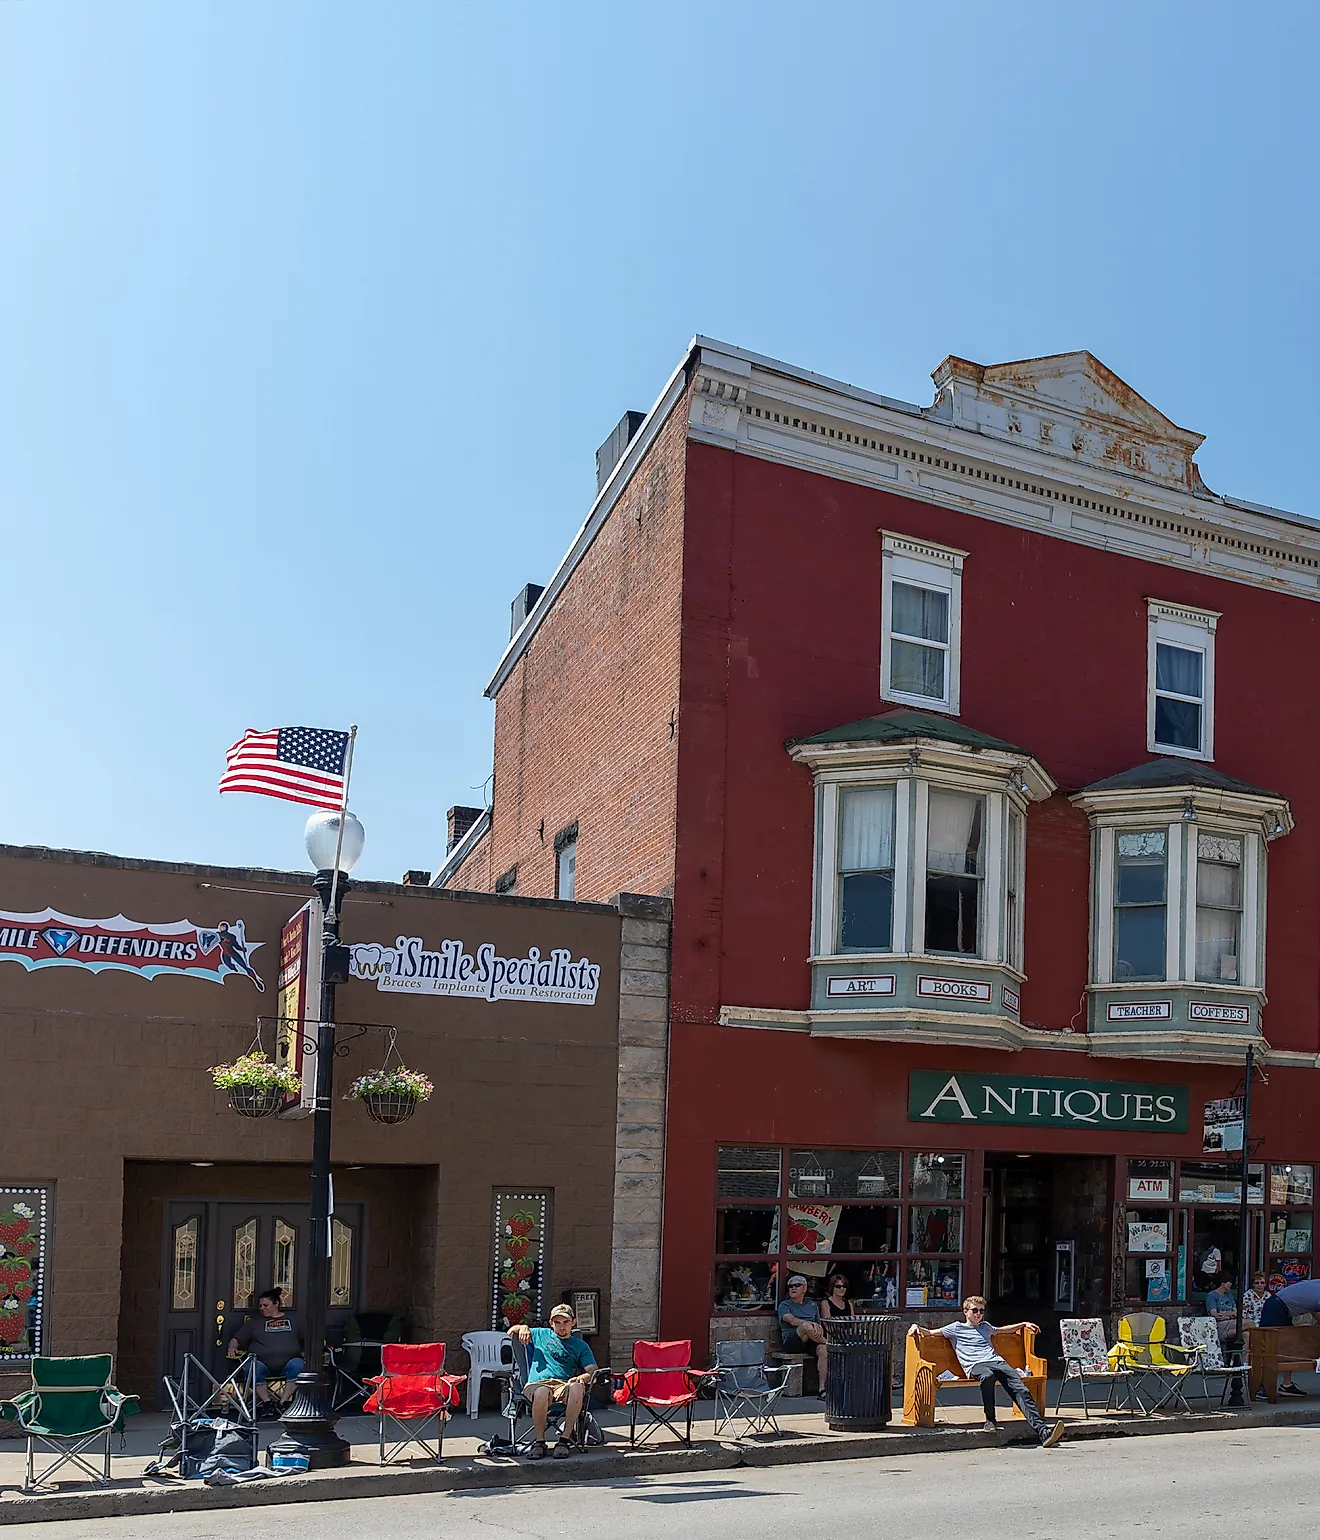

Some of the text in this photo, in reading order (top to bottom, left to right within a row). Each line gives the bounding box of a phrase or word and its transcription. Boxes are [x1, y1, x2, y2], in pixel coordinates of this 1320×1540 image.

[79, 934, 198, 960] DEFENDERS
[395, 938, 598, 999] iSmile Specialists
[382, 975, 594, 1001] Braces Implants Gum Restoration
[846, 980, 876, 992] ART
[933, 982, 978, 997] BOOKS
[1117, 1006, 1162, 1016] TEACHER
[1193, 1006, 1244, 1019] COFFEES
[920, 1076, 1177, 1123] ANTIQUES
[1137, 1180, 1163, 1192] ATM
[1284, 1263, 1309, 1276] OPEN
